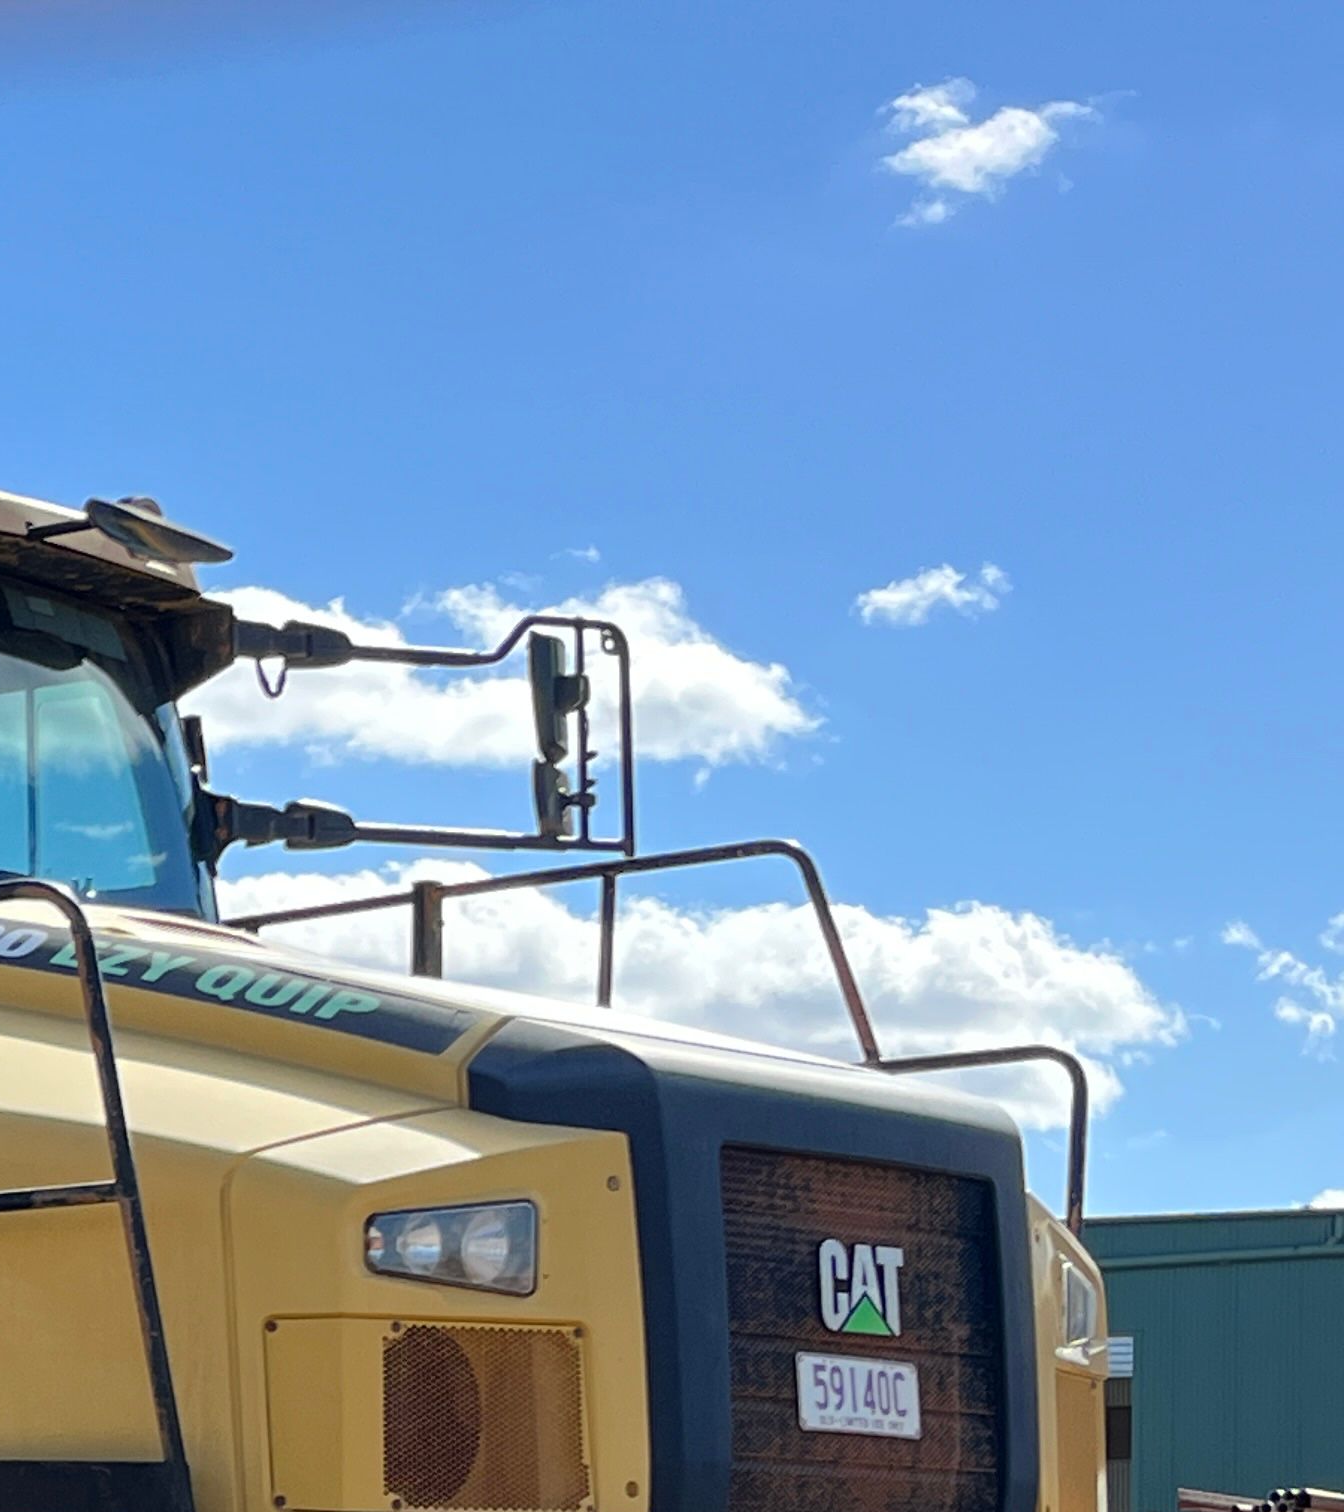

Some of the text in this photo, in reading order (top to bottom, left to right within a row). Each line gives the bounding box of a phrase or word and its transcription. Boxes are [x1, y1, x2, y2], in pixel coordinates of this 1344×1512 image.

[194, 964, 381, 1021] QUIP
[818, 1237, 905, 1337] CAT
[812, 1363, 909, 1418] 59140C
